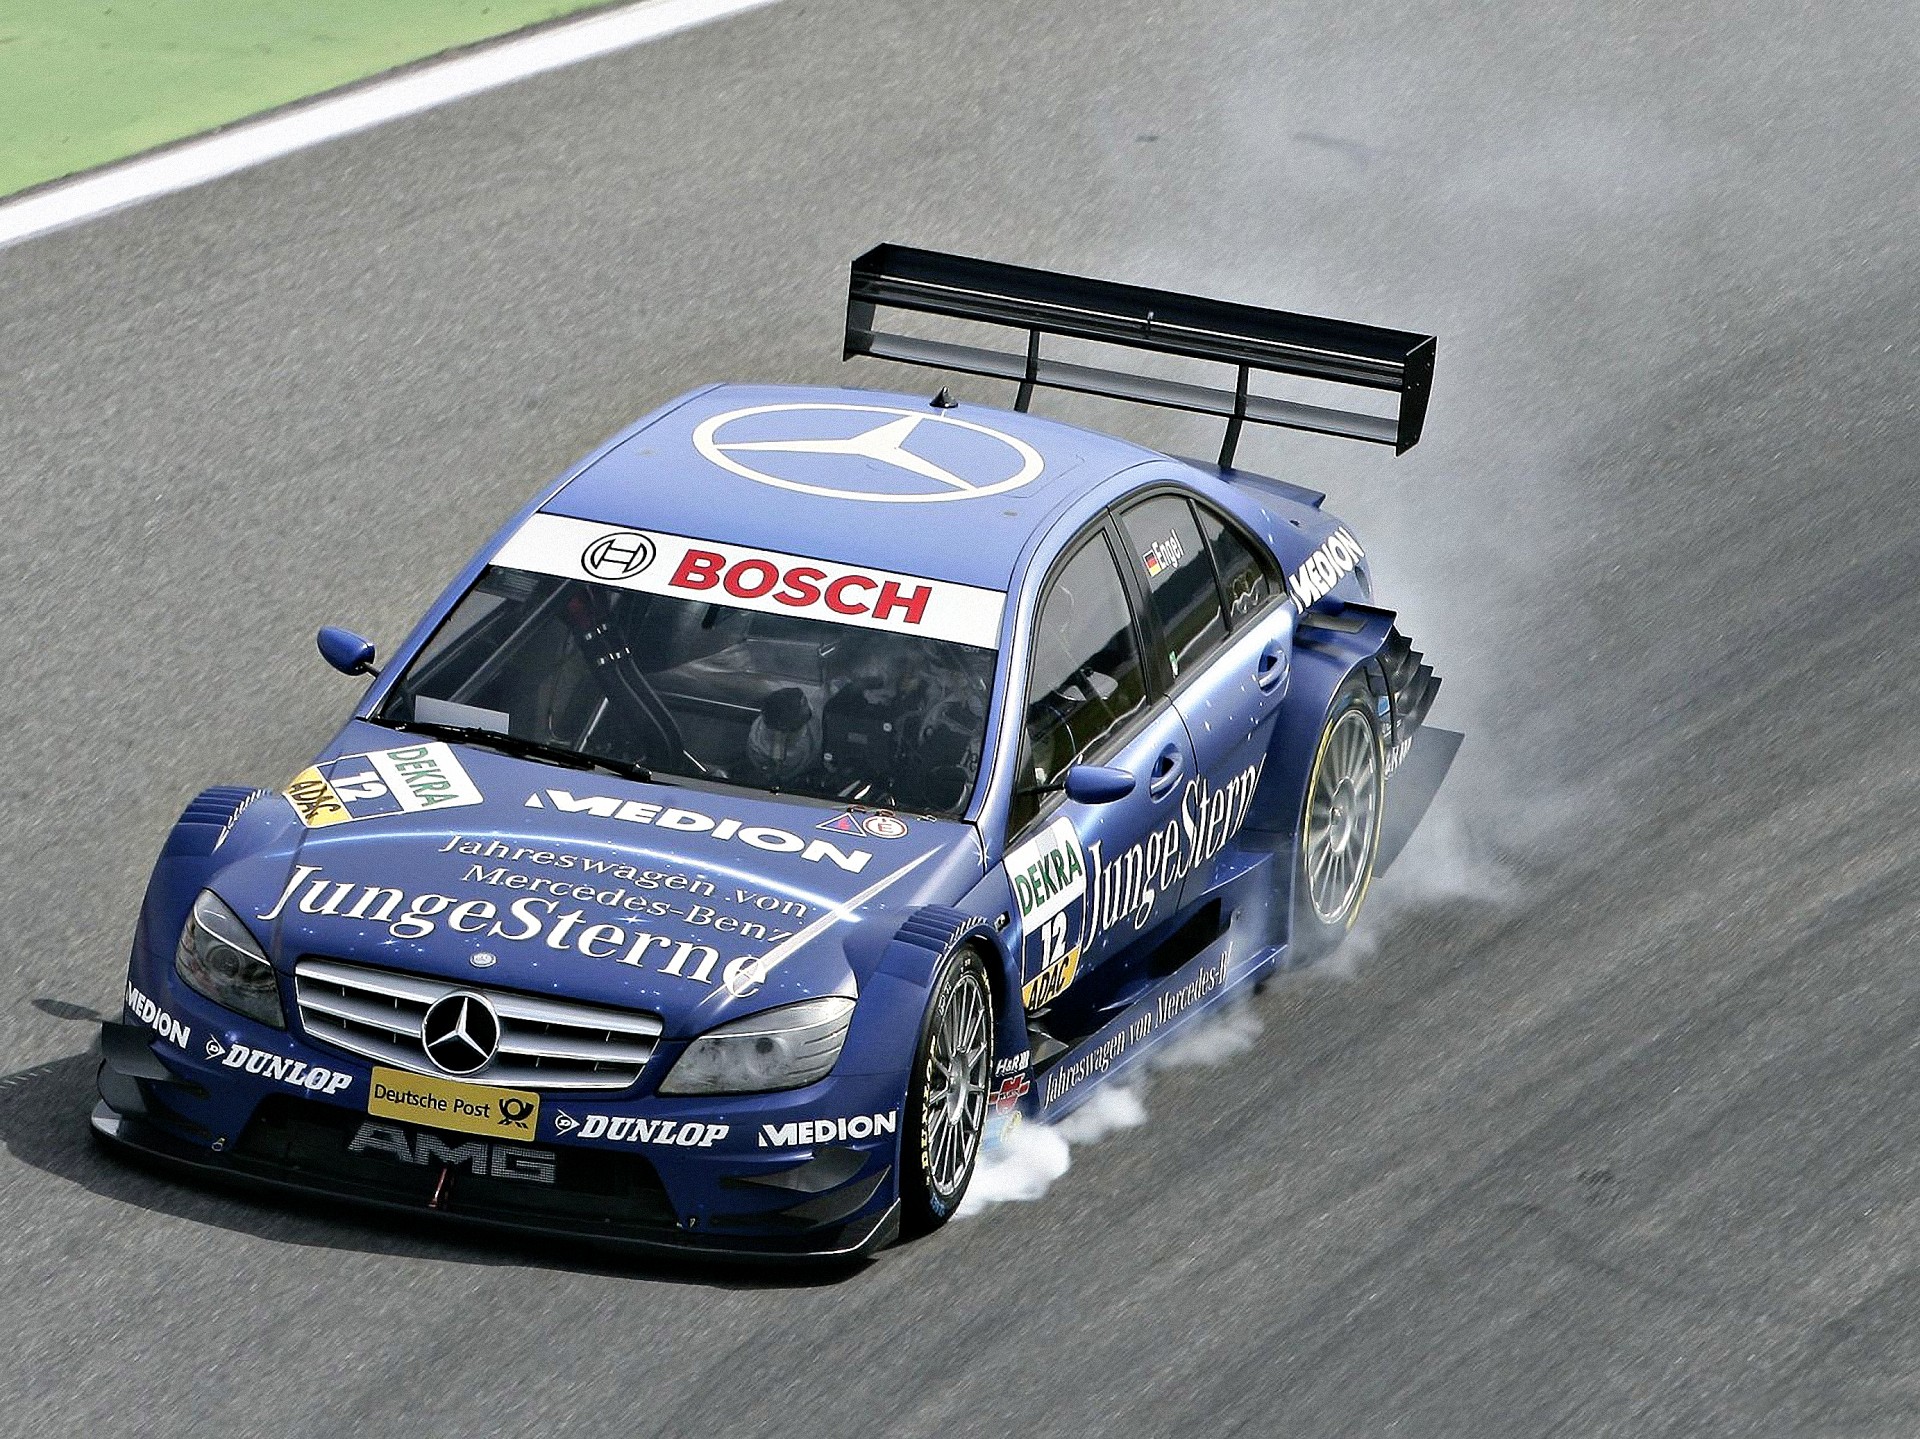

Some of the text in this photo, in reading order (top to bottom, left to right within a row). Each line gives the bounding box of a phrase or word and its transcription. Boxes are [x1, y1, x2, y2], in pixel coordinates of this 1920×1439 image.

[1151, 528, 1185, 569] Engel
[1288, 526, 1365, 614] MEDION
[668, 548, 932, 624] BOSCH
[288, 780, 342, 821] ADAC
[329, 771, 388, 803] 12
[386, 747, 460, 807] DEKRA
[524, 789, 873, 874] MEDION
[1082, 752, 1267, 954] JungeStern
[439, 834, 807, 919] Jahreswagen von
[461, 864, 794, 943] Mercedes-Benz
[1014, 840, 1083, 917] DEKRA
[257, 864, 767, 998] JungeSterne
[1041, 910, 1067, 970] 12
[126, 980, 191, 1049] MEDION
[1027, 955, 1070, 1011] ADAC
[222, 1043, 353, 1095] DUNLOP
[1043, 1030, 1126, 1112] Jahreswagen
[1129, 1011, 1152, 1046] von
[374, 1083, 491, 1118] Deutsche Post
[577, 1113, 730, 1148] DUNLOP
[757, 1110, 897, 1147] MEDION
[347, 1119, 556, 1184] AMG
